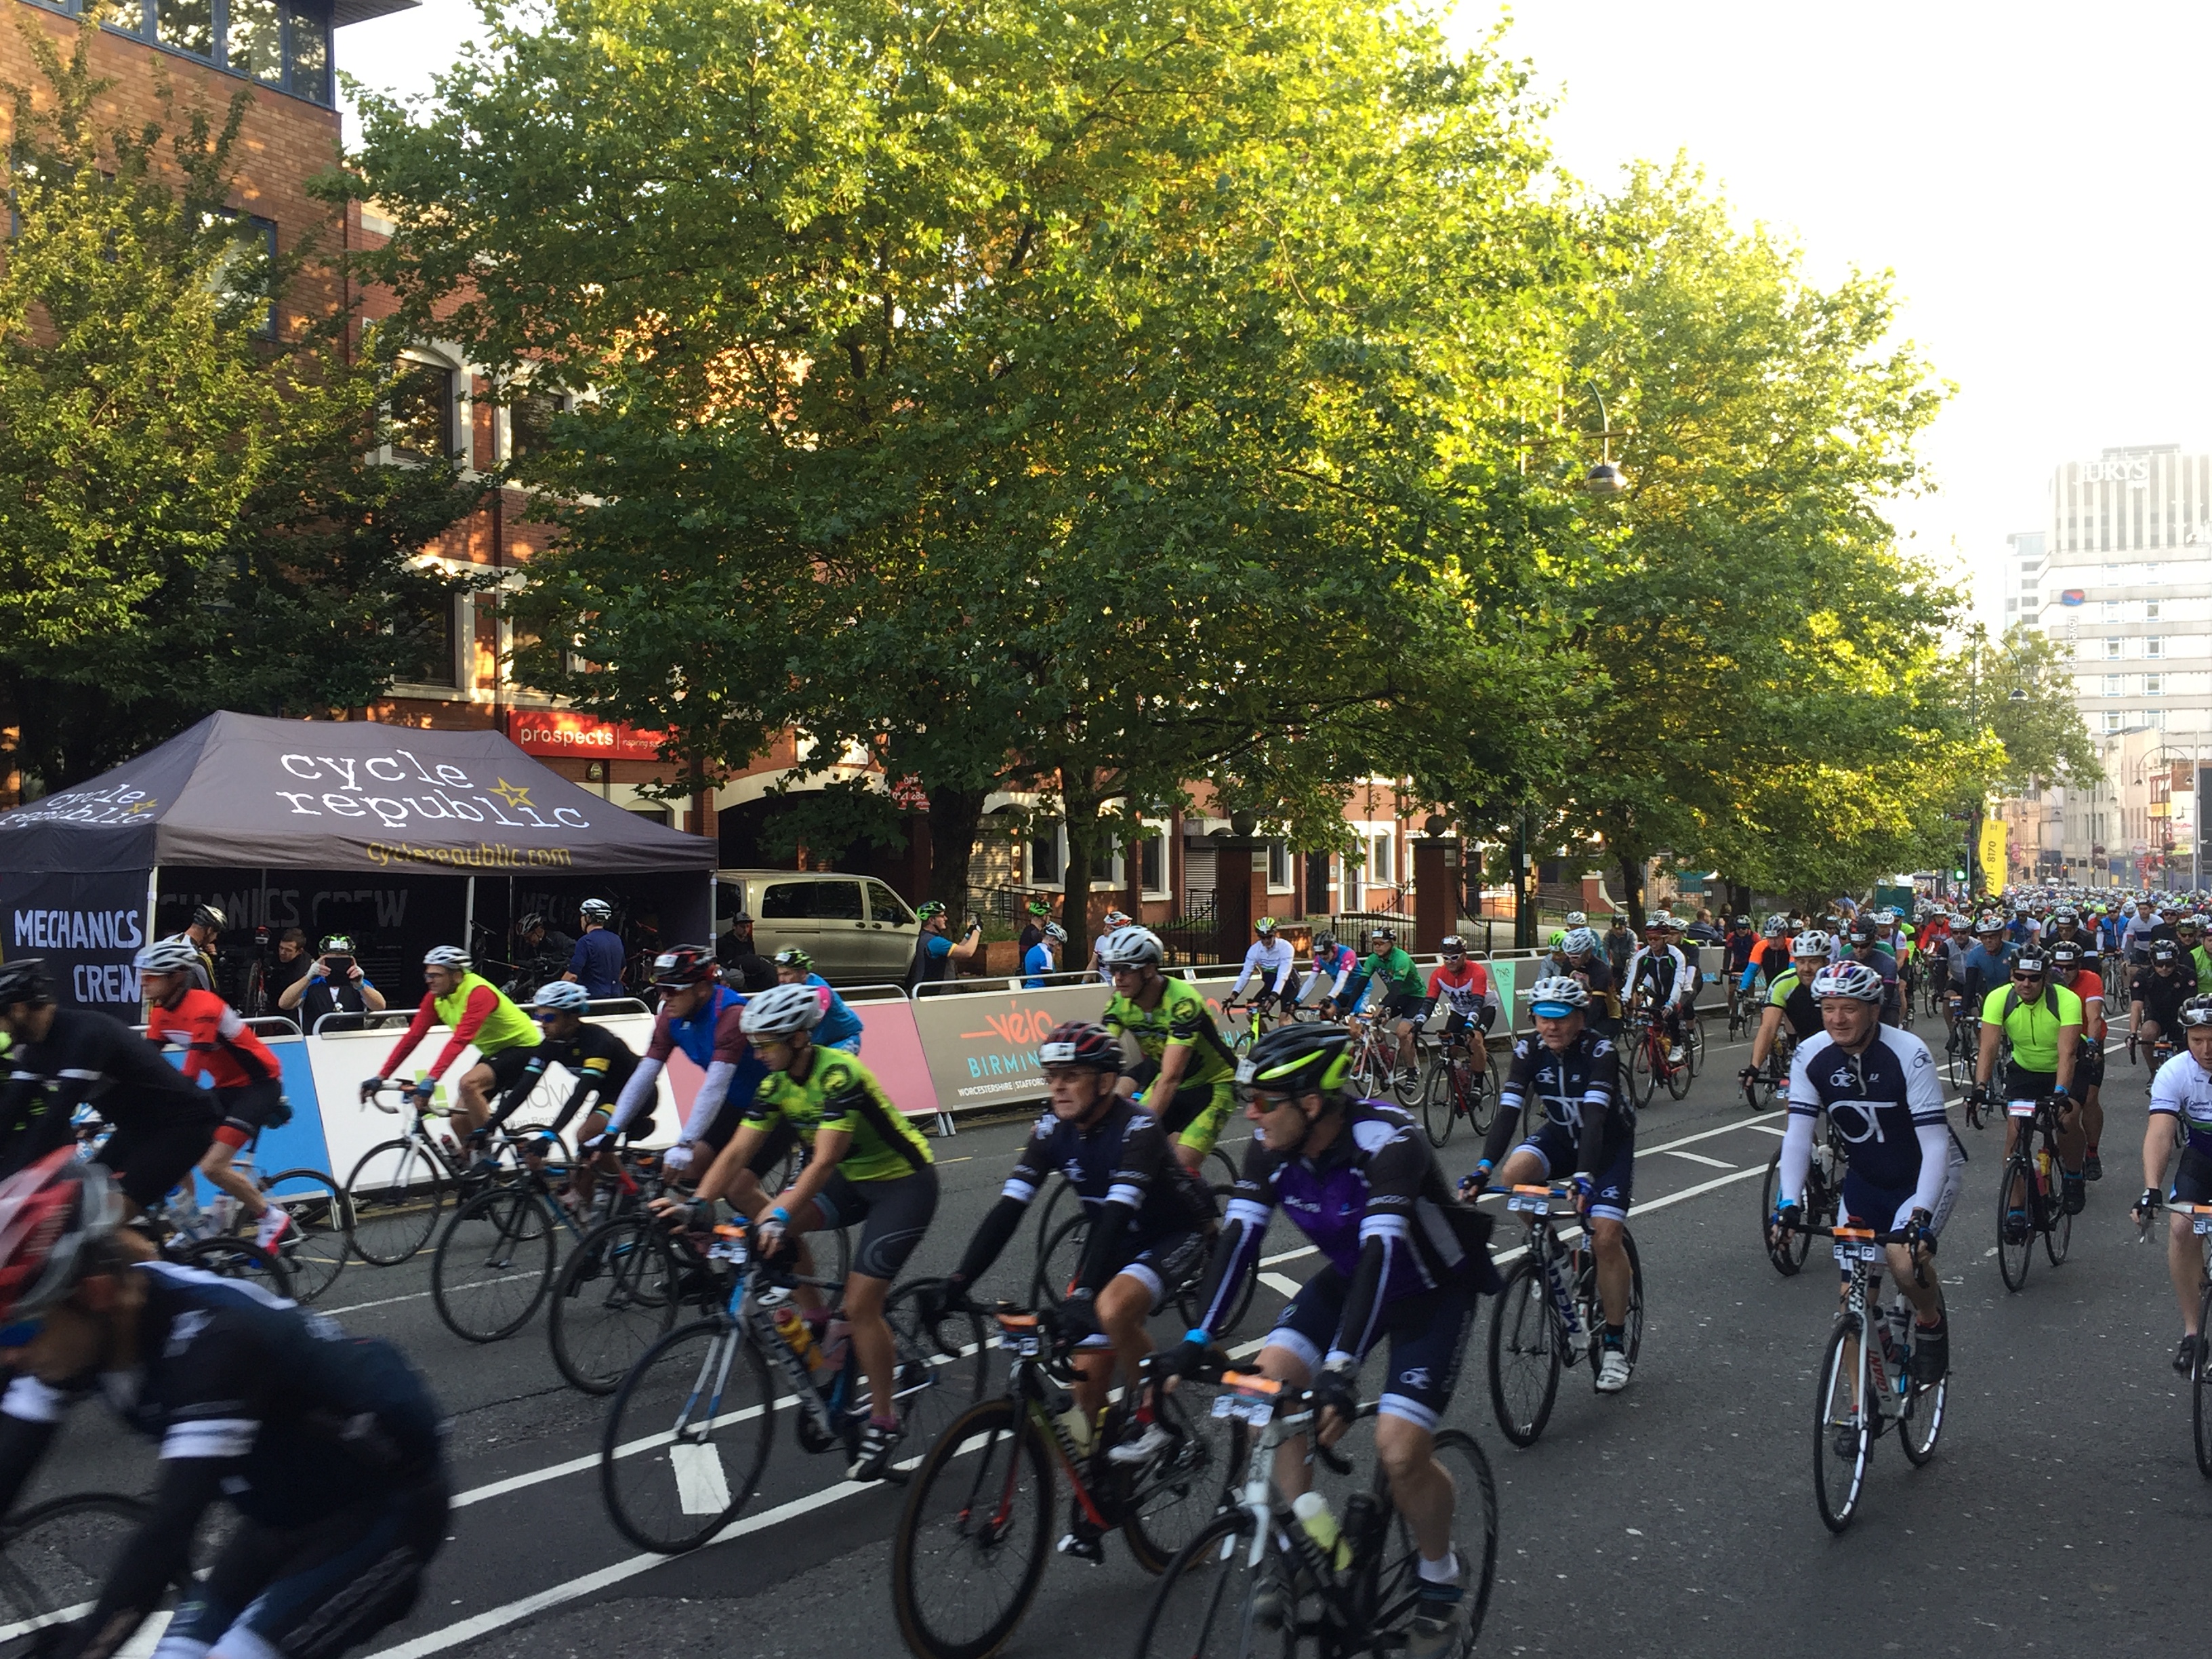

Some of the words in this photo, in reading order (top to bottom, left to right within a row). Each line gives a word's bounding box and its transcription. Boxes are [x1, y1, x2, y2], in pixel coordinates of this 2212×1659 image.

[2072, 459, 2148, 485] JURYS
[520, 729, 613, 747] prospects
[280, 749, 474, 792] cycle
[46, 783, 146, 810] cycle
[275, 789, 590, 828] republic
[0, 804, 155, 828] republic
[366, 842, 573, 867] cyclerepublic.com
[1986, 840, 1997, 863] 8170
[14, 909, 142, 949] MECHANICS
[73, 964, 142, 1003] CREW
[967, 1050, 1042, 1078] BIRMIN
[957, 1082, 1014, 1097] WORCESTERSHIRE
[1866, 1349, 1889, 1392] GIANT
